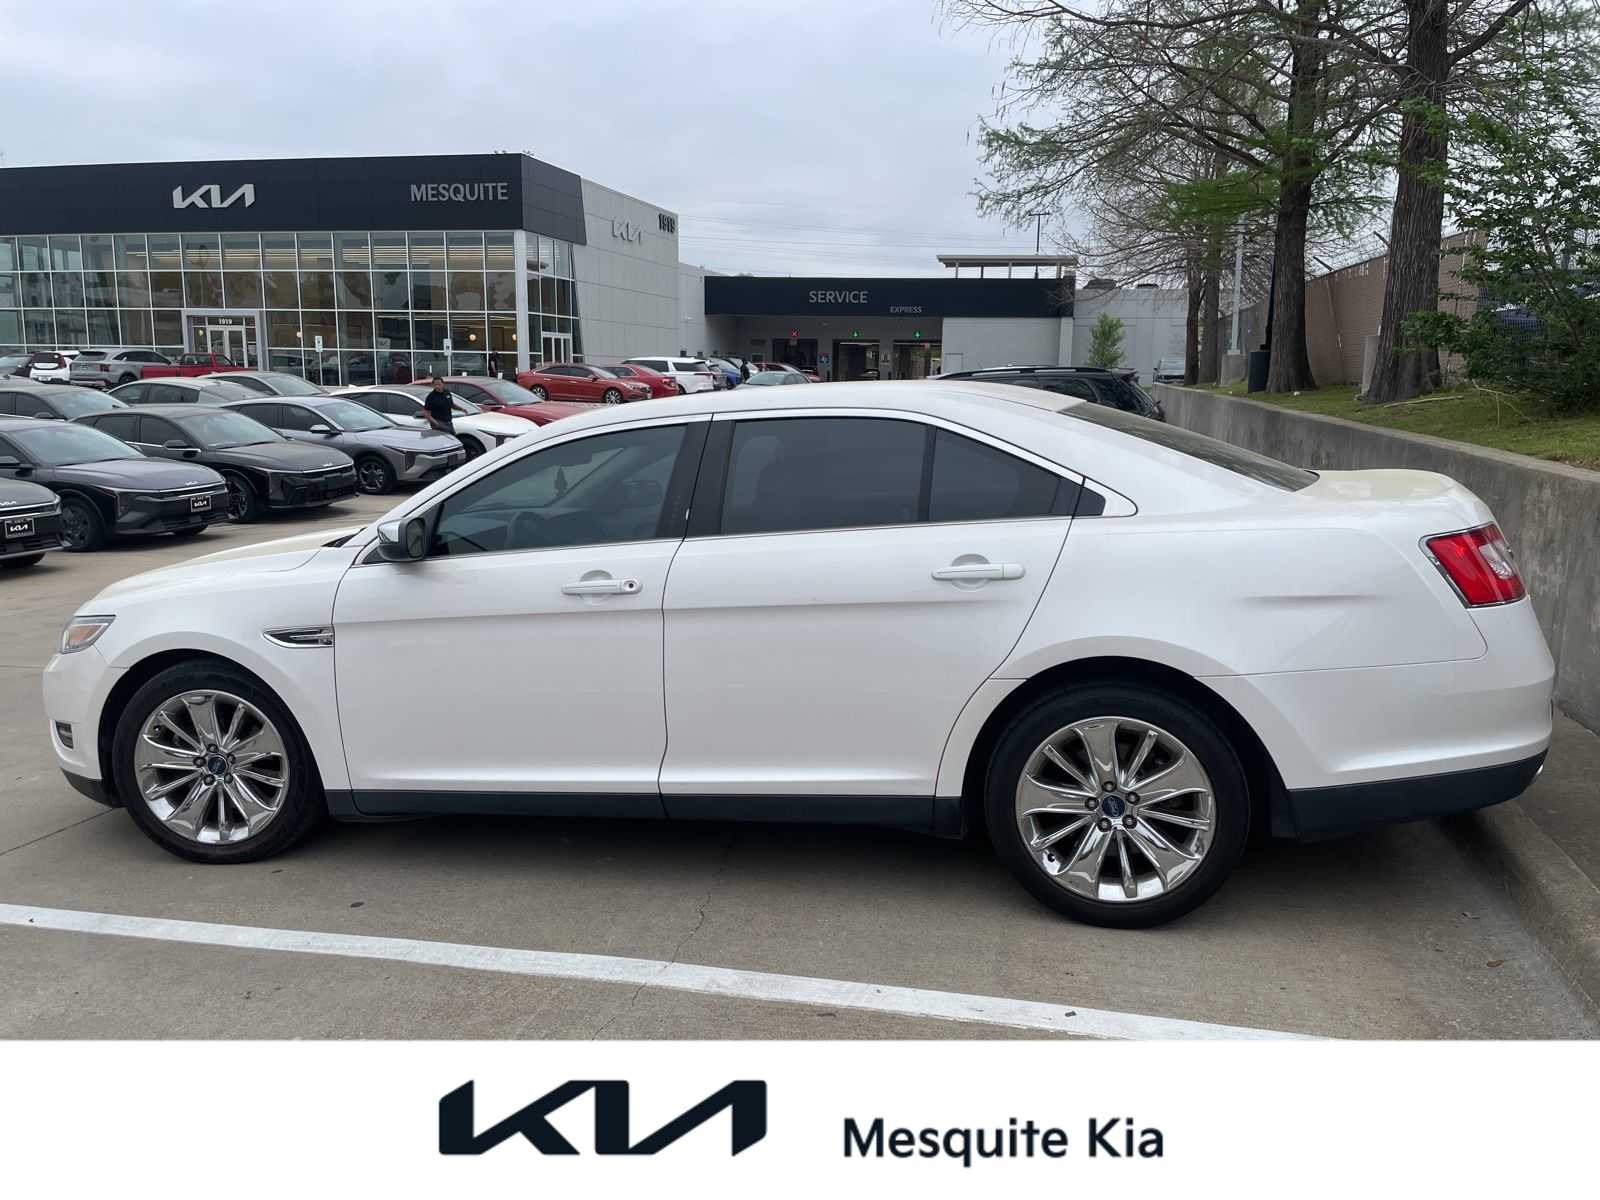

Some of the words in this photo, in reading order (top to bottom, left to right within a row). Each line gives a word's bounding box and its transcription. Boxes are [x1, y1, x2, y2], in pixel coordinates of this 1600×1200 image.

[410, 182, 509, 202] MESQUITE
[658, 213, 676, 234] 1919
[808, 290, 869, 304] SERVICE
[890, 305, 923, 314] EXPRESS
